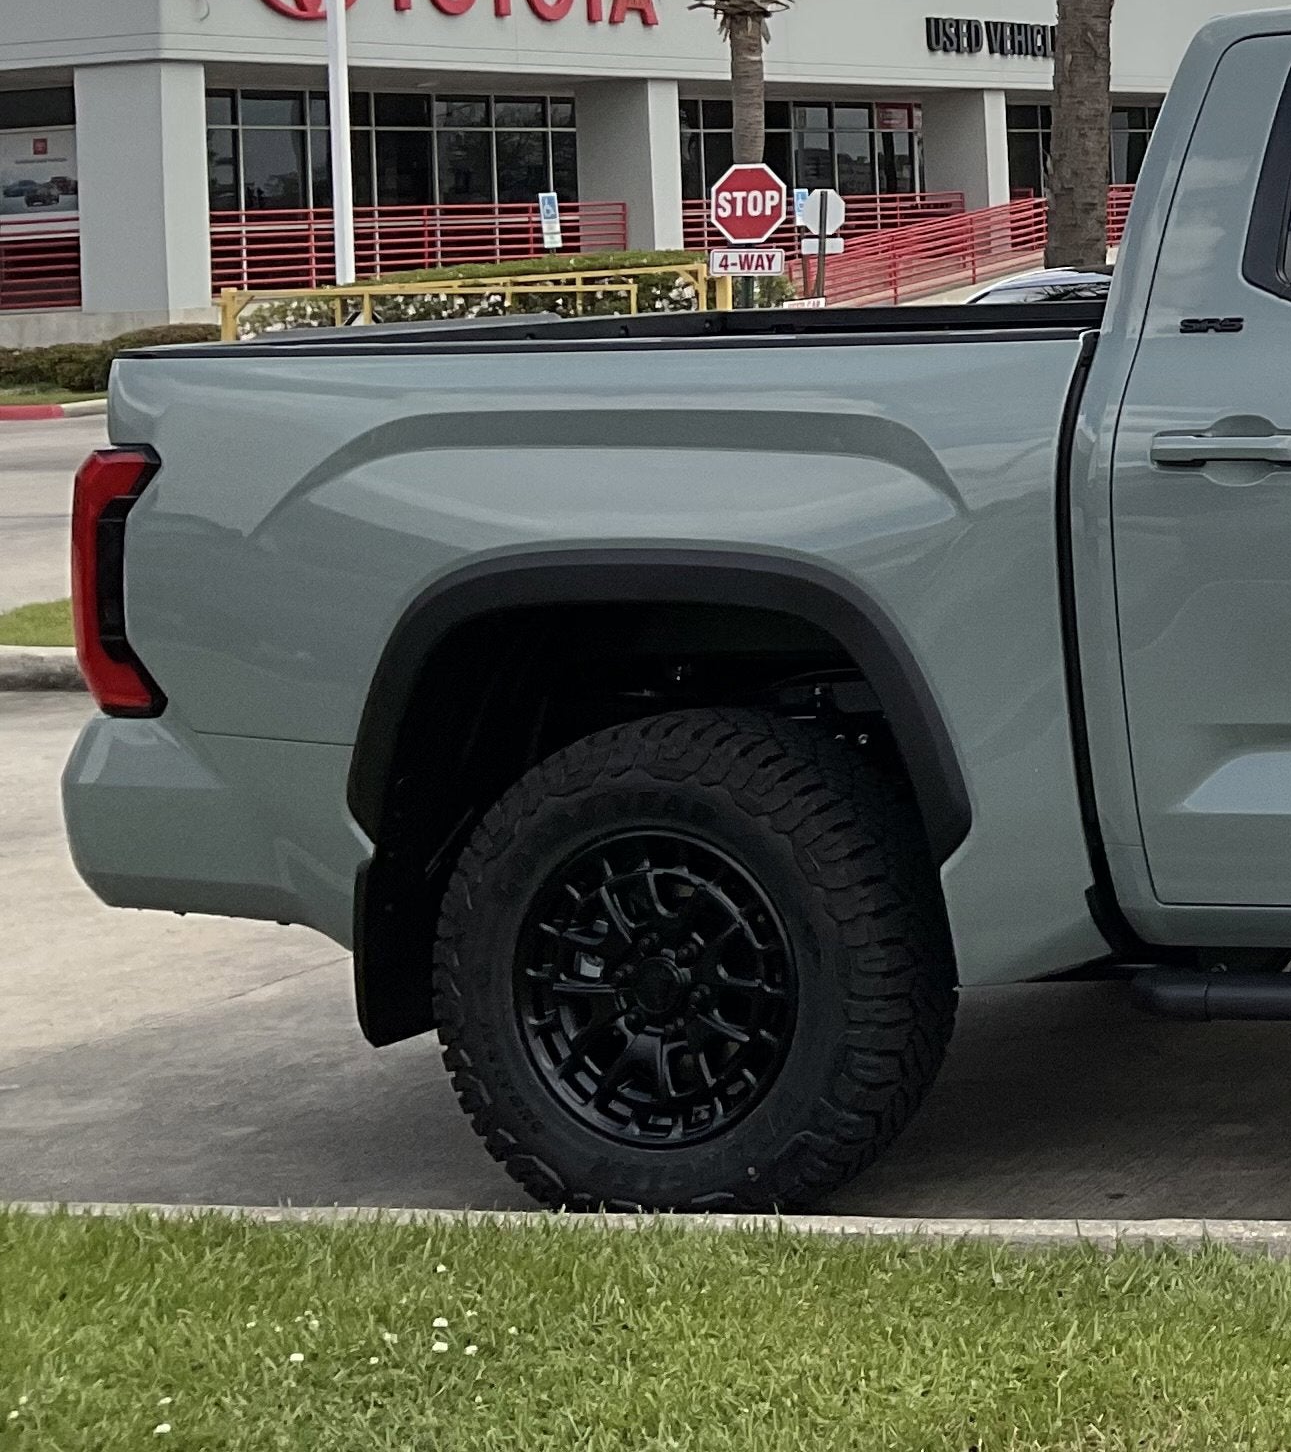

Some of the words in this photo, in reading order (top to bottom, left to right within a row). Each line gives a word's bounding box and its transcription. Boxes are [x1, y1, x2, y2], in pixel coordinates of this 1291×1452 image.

[925, 17, 983, 53] USED
[984, 20, 1056, 58] VEHICL
[717, 190, 780, 218] STOP
[718, 254, 776, 271] 4-WAY
[1180, 317, 1244, 333] SR5
